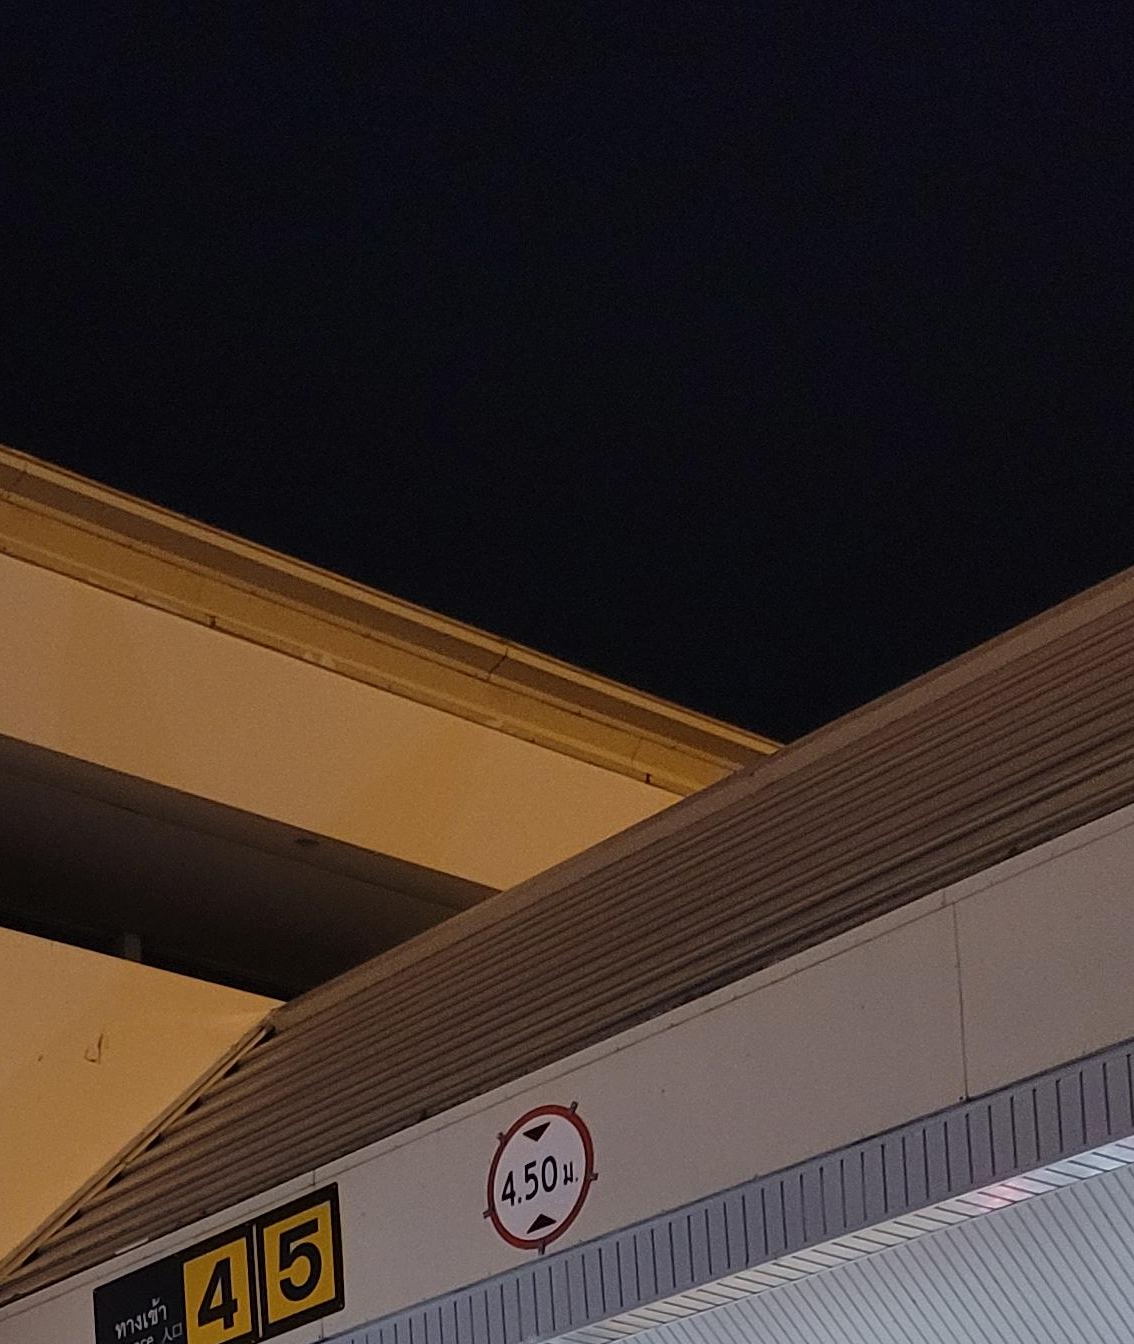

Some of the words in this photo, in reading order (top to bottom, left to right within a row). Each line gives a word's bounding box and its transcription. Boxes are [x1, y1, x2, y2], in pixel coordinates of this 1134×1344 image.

[501, 1155, 558, 1206] 4.50
[563, 1161, 579, 1186] ม.
[279, 1217, 322, 1302] 5
[115, 1297, 168, 1340] ทางเข้า
[197, 1257, 238, 1331] 4
